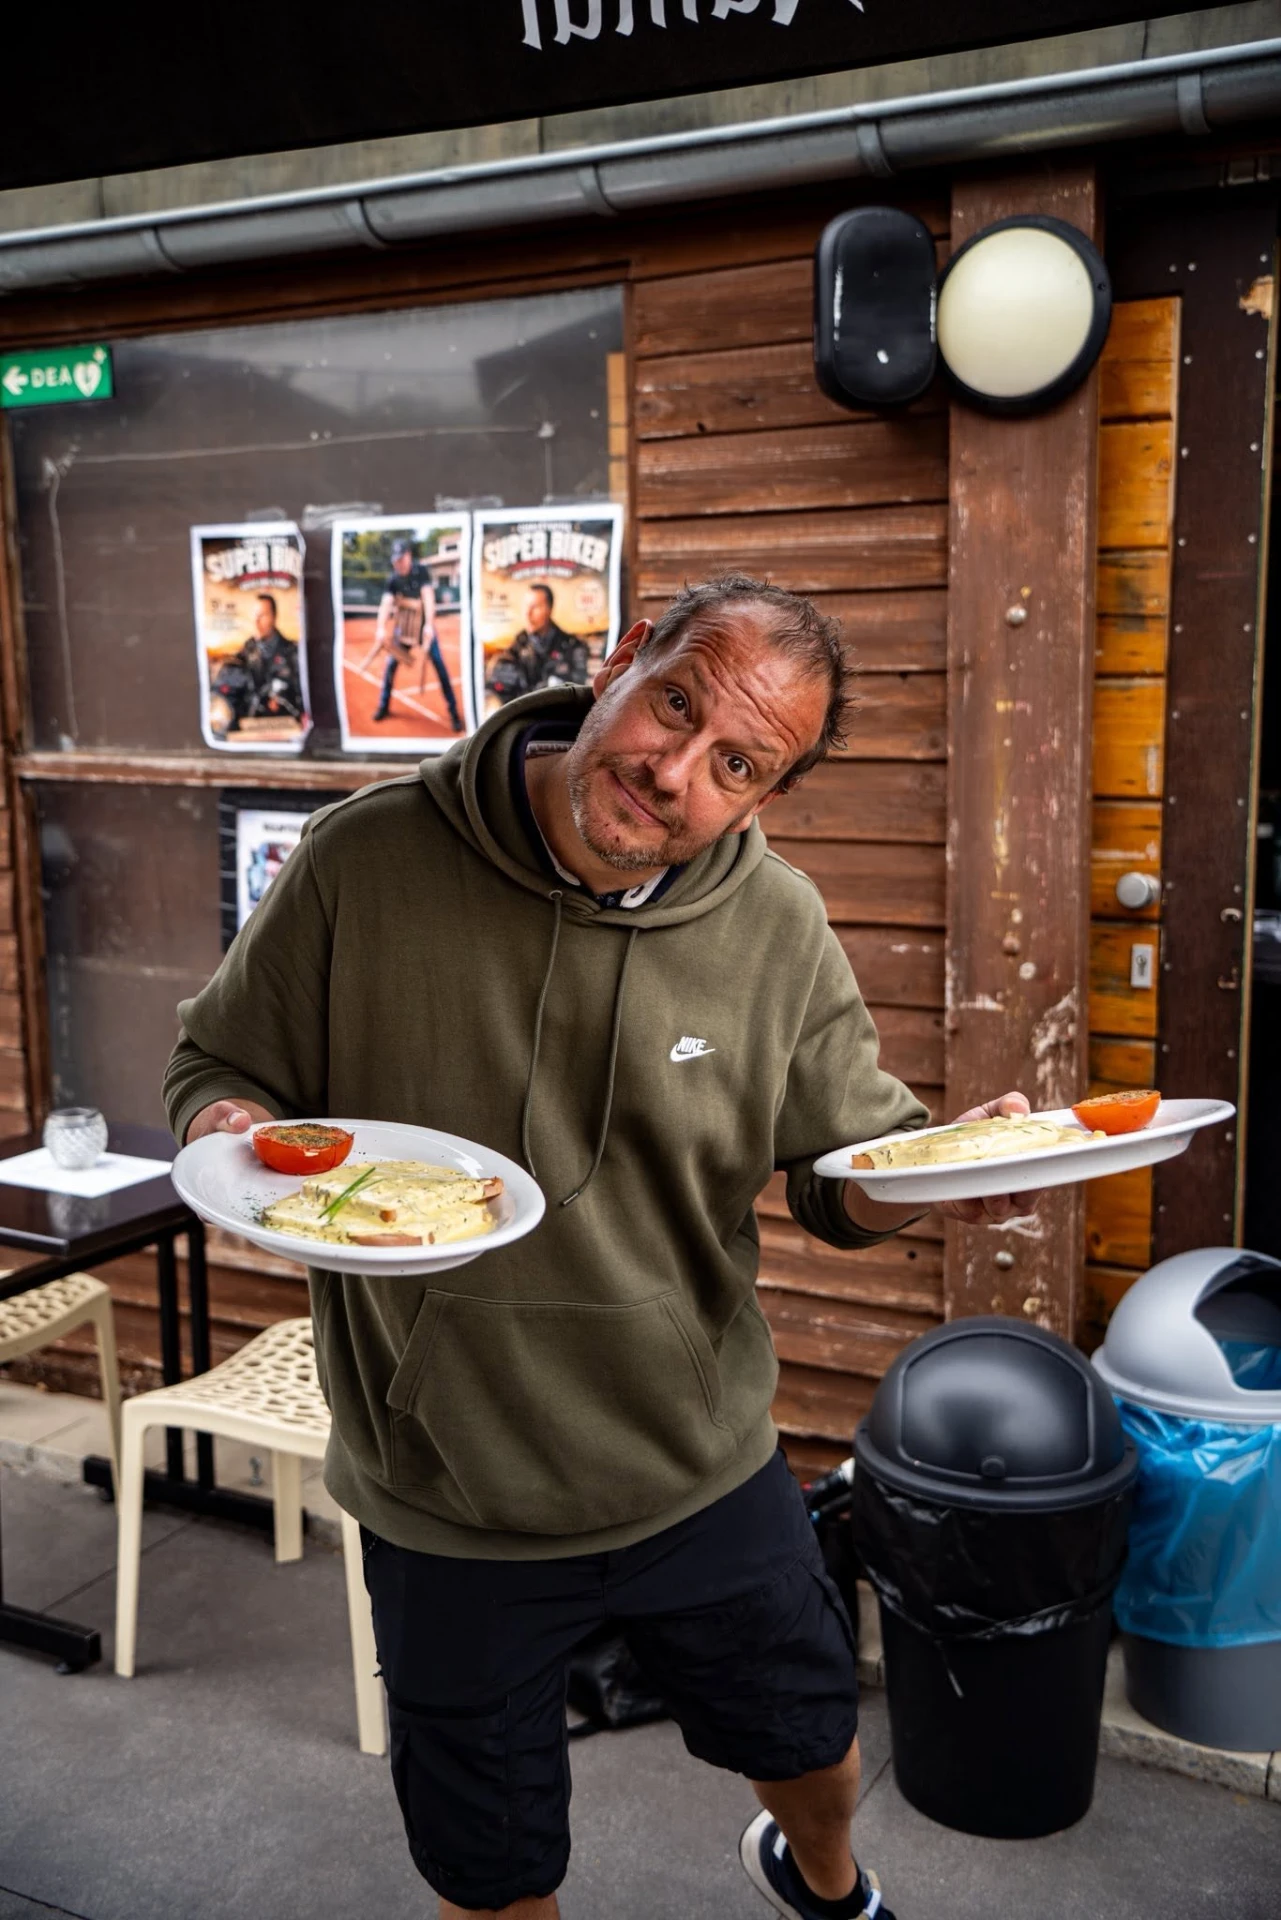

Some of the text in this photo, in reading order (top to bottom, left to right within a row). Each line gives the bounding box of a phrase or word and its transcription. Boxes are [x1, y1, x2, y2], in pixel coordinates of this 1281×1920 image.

[30, 365, 73, 389] DEA
[206, 545, 269, 582] SUPER
[484, 531, 608, 572] SUPER BIKER
[676, 1036, 707, 1053] NIKE
